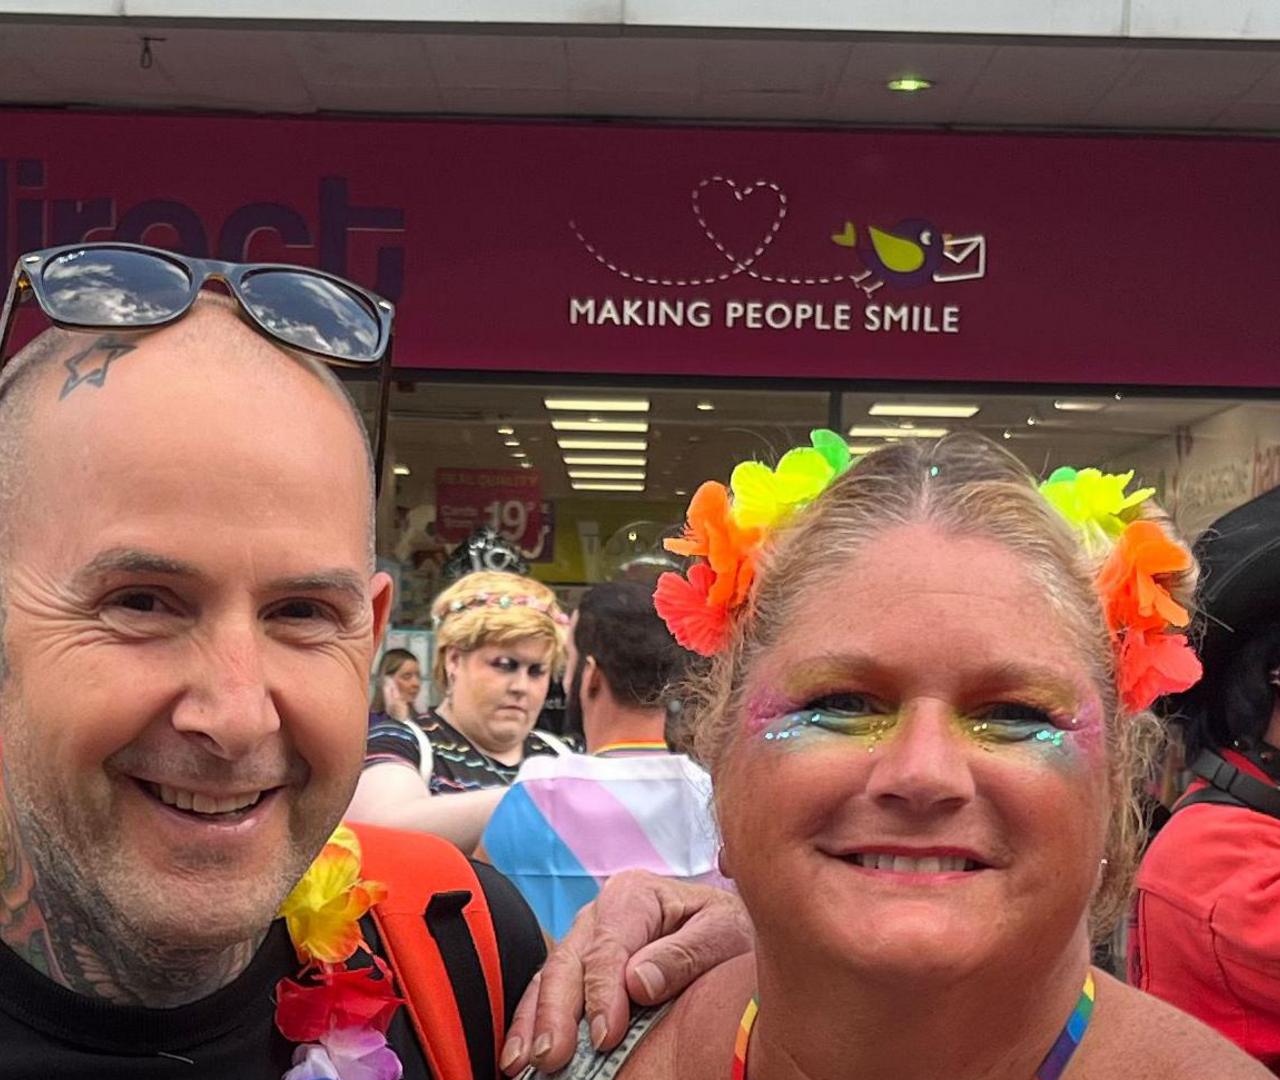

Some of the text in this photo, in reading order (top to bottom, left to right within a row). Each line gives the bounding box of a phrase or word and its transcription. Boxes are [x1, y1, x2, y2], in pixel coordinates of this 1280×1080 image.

[569, 299, 960, 332] MAKING PEOPLE SMILE
